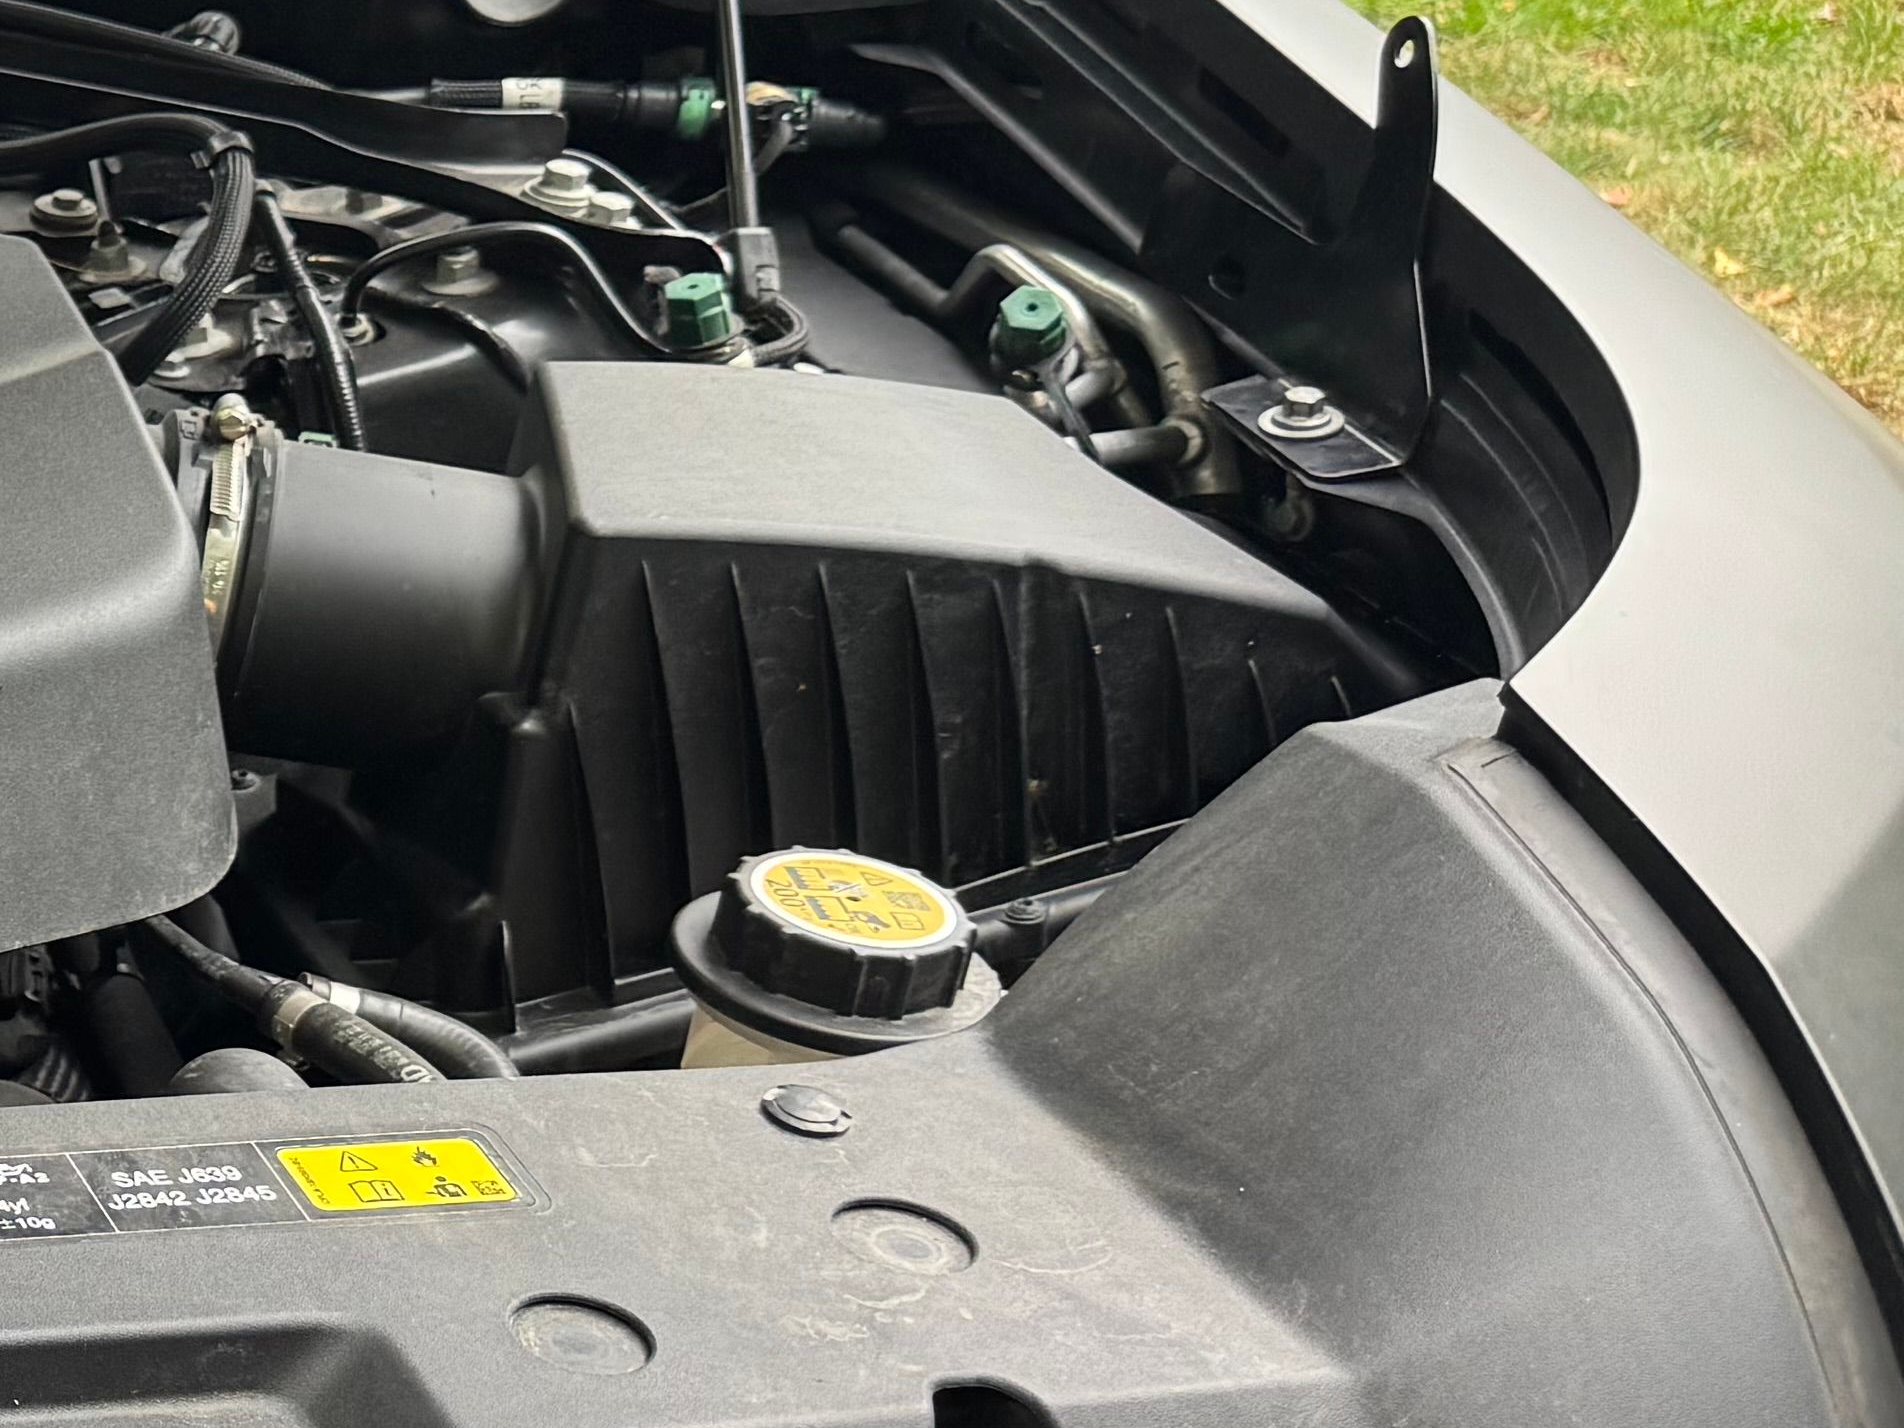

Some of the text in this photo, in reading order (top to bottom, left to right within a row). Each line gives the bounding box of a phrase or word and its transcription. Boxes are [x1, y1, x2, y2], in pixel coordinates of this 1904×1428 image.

[111, 1165, 242, 1188] SAE J639
[108, 1185, 277, 1210] J2842 J2845
